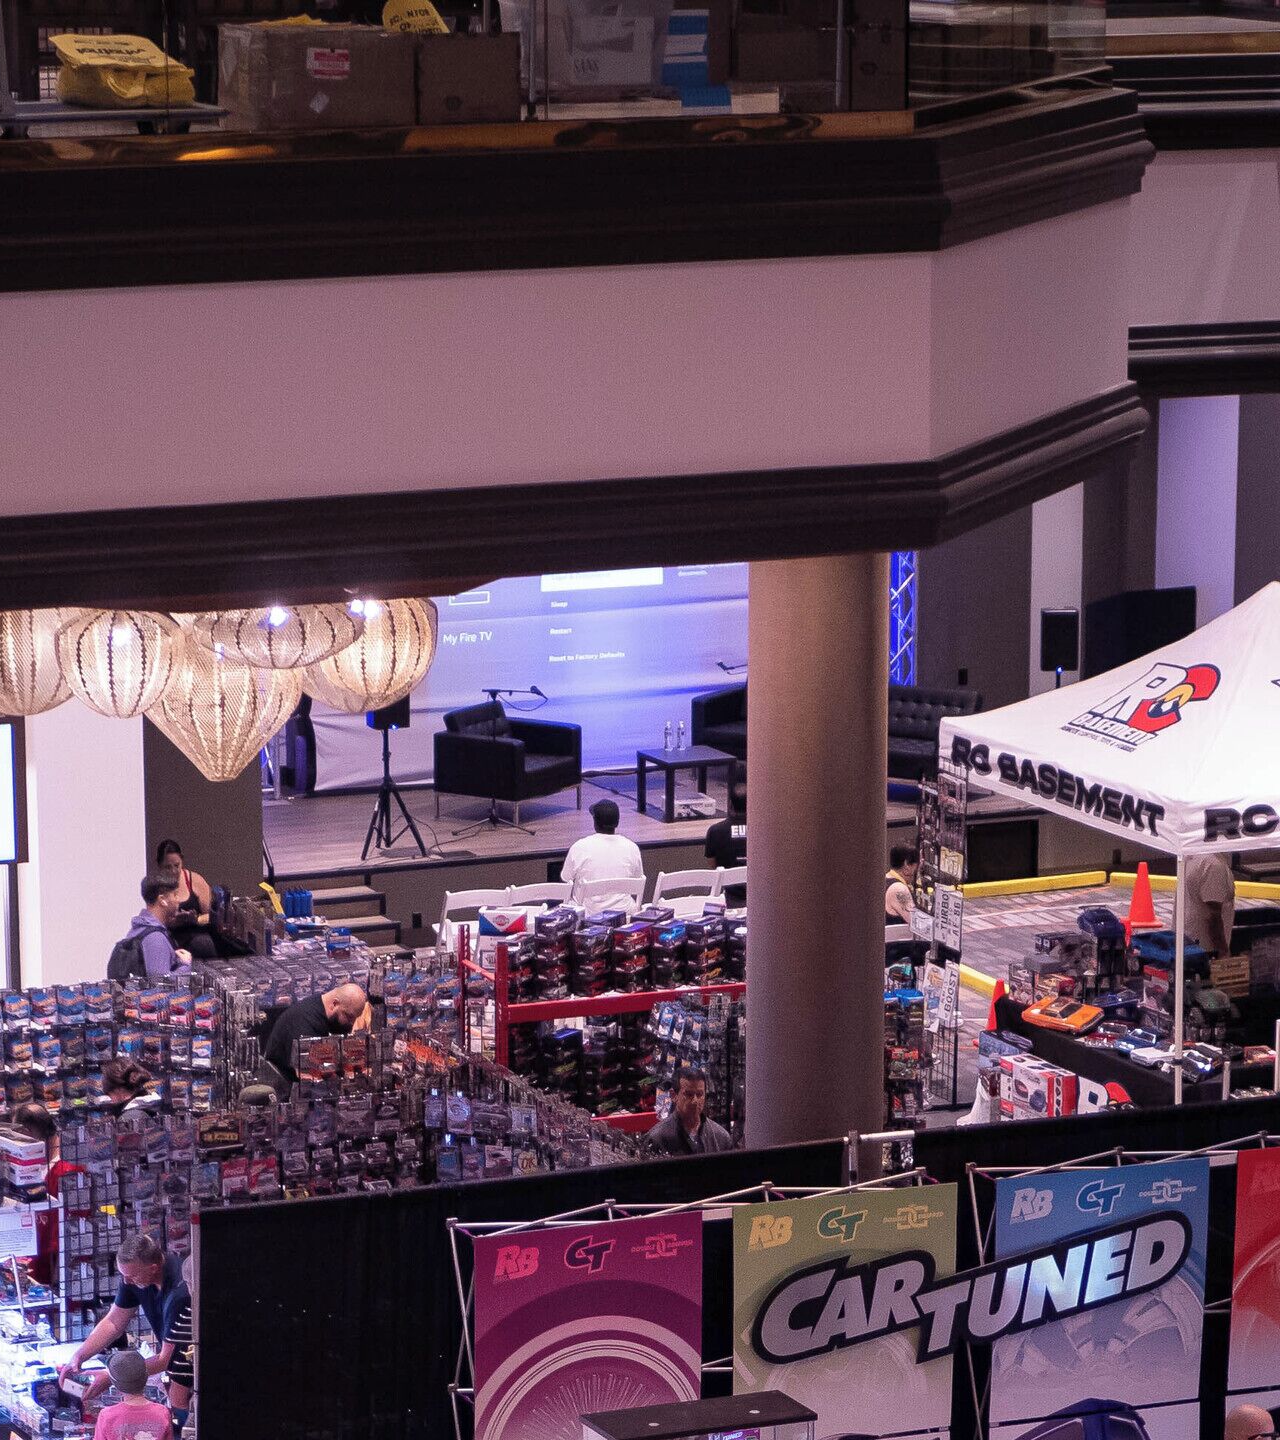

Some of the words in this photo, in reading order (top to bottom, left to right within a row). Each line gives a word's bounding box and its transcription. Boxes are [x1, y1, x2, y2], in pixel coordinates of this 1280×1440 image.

[443, 634, 457, 645] My
[459, 632, 477, 642] Fire
[480, 631, 493, 641] TV
[1068, 713, 1159, 747] BASEMENT
[951, 735, 990, 774] RC
[998, 752, 1166, 837] BASEMENT
[1203, 805, 1280, 842] RC
[1010, 1187, 1053, 1224] RB
[748, 1214, 793, 1252] RB
